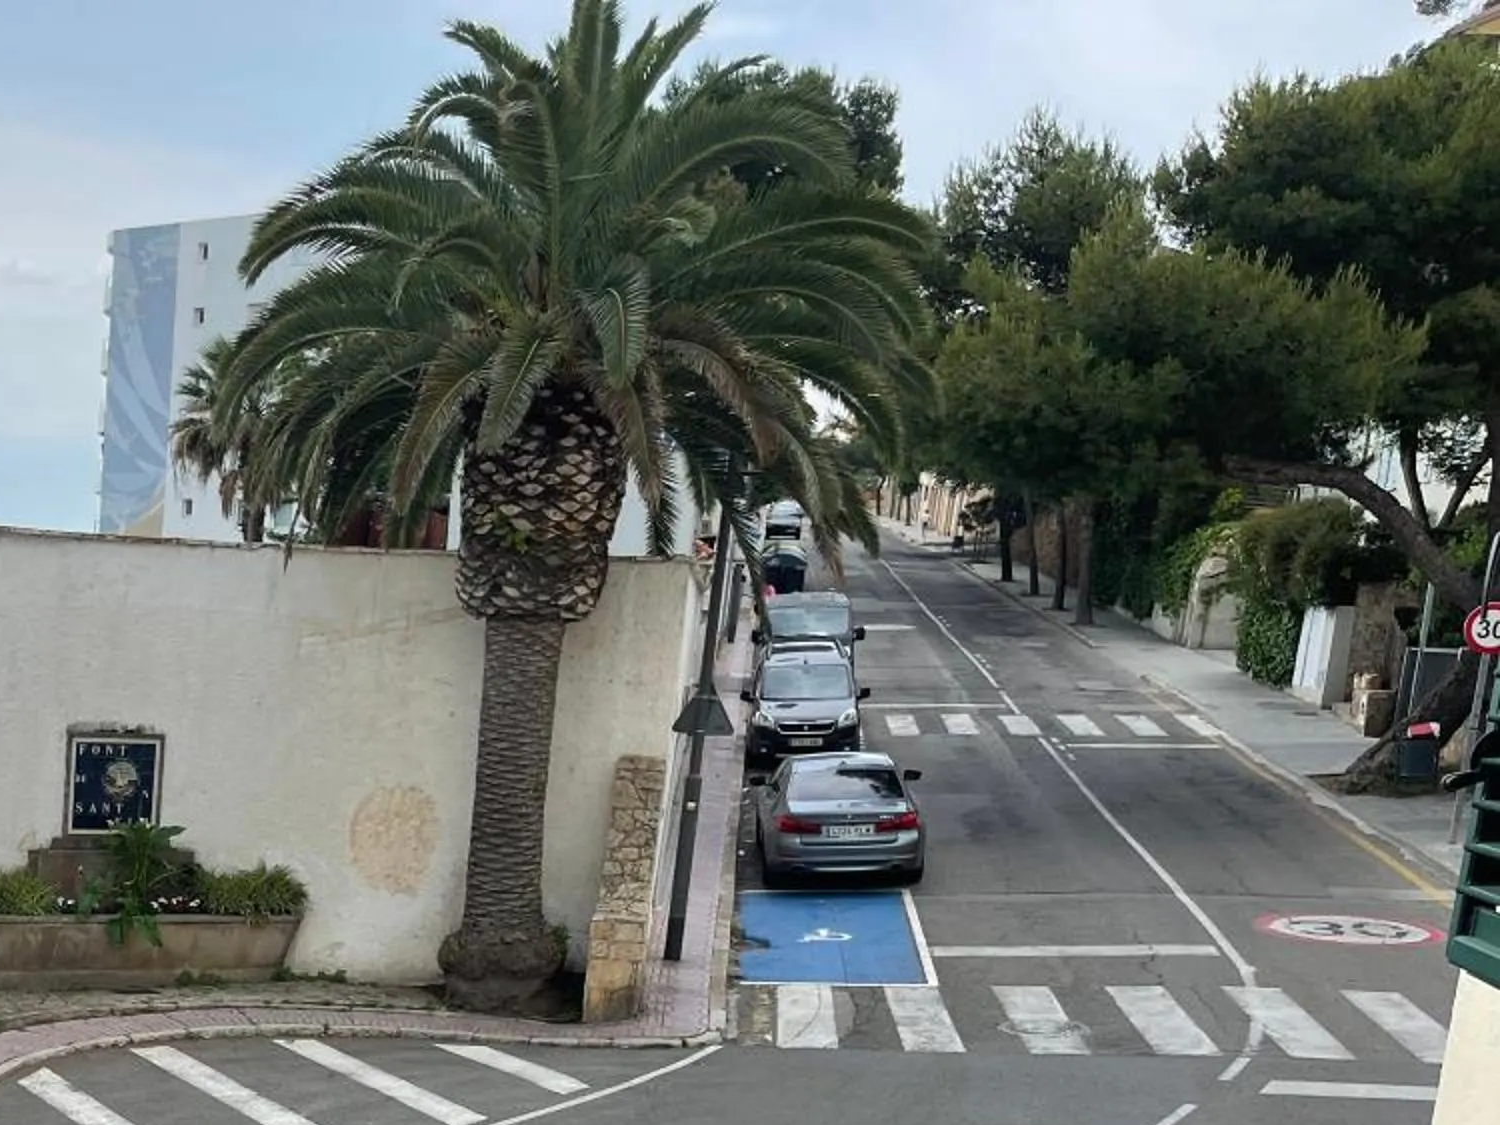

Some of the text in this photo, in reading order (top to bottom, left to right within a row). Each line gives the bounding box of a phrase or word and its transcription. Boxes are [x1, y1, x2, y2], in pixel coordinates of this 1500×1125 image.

[79, 744, 128, 756] FONT
[75, 802, 124, 814] SANT
[1288, 917, 1409, 939] 30
